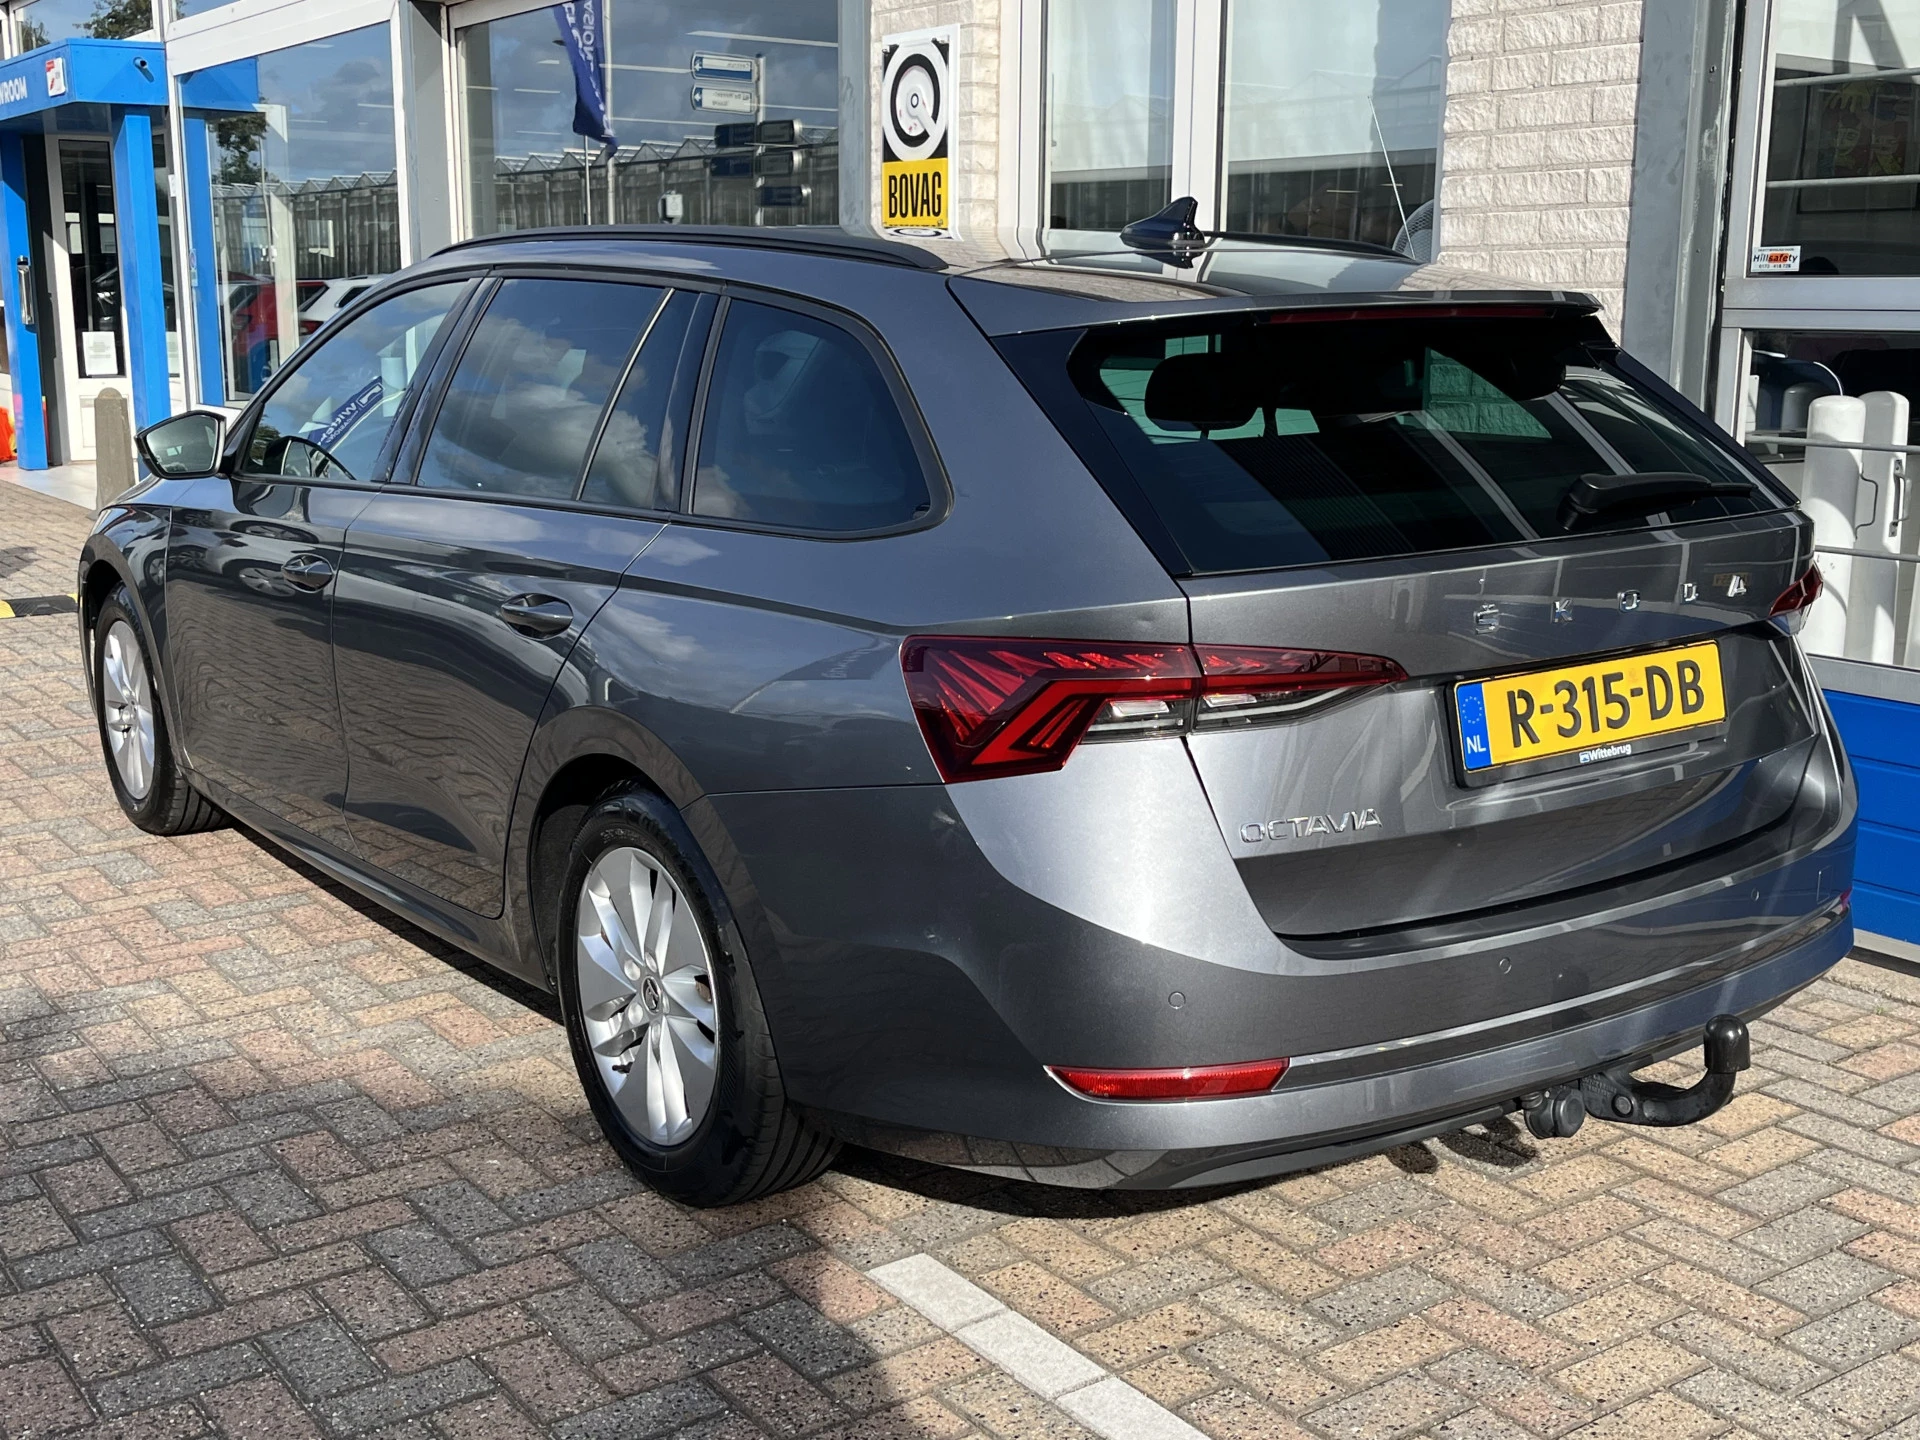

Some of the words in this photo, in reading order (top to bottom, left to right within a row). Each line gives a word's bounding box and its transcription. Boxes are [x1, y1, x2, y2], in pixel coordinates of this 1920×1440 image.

[889, 171, 942, 218] BOVAG
[1753, 253, 1798, 263] Hillsafety
[1508, 659, 1705, 748] R-315-DB
[1466, 734, 1487, 755] NL
[1589, 744, 1632, 761] Wittebrug
[1240, 807, 1384, 845] OCTAVIA
